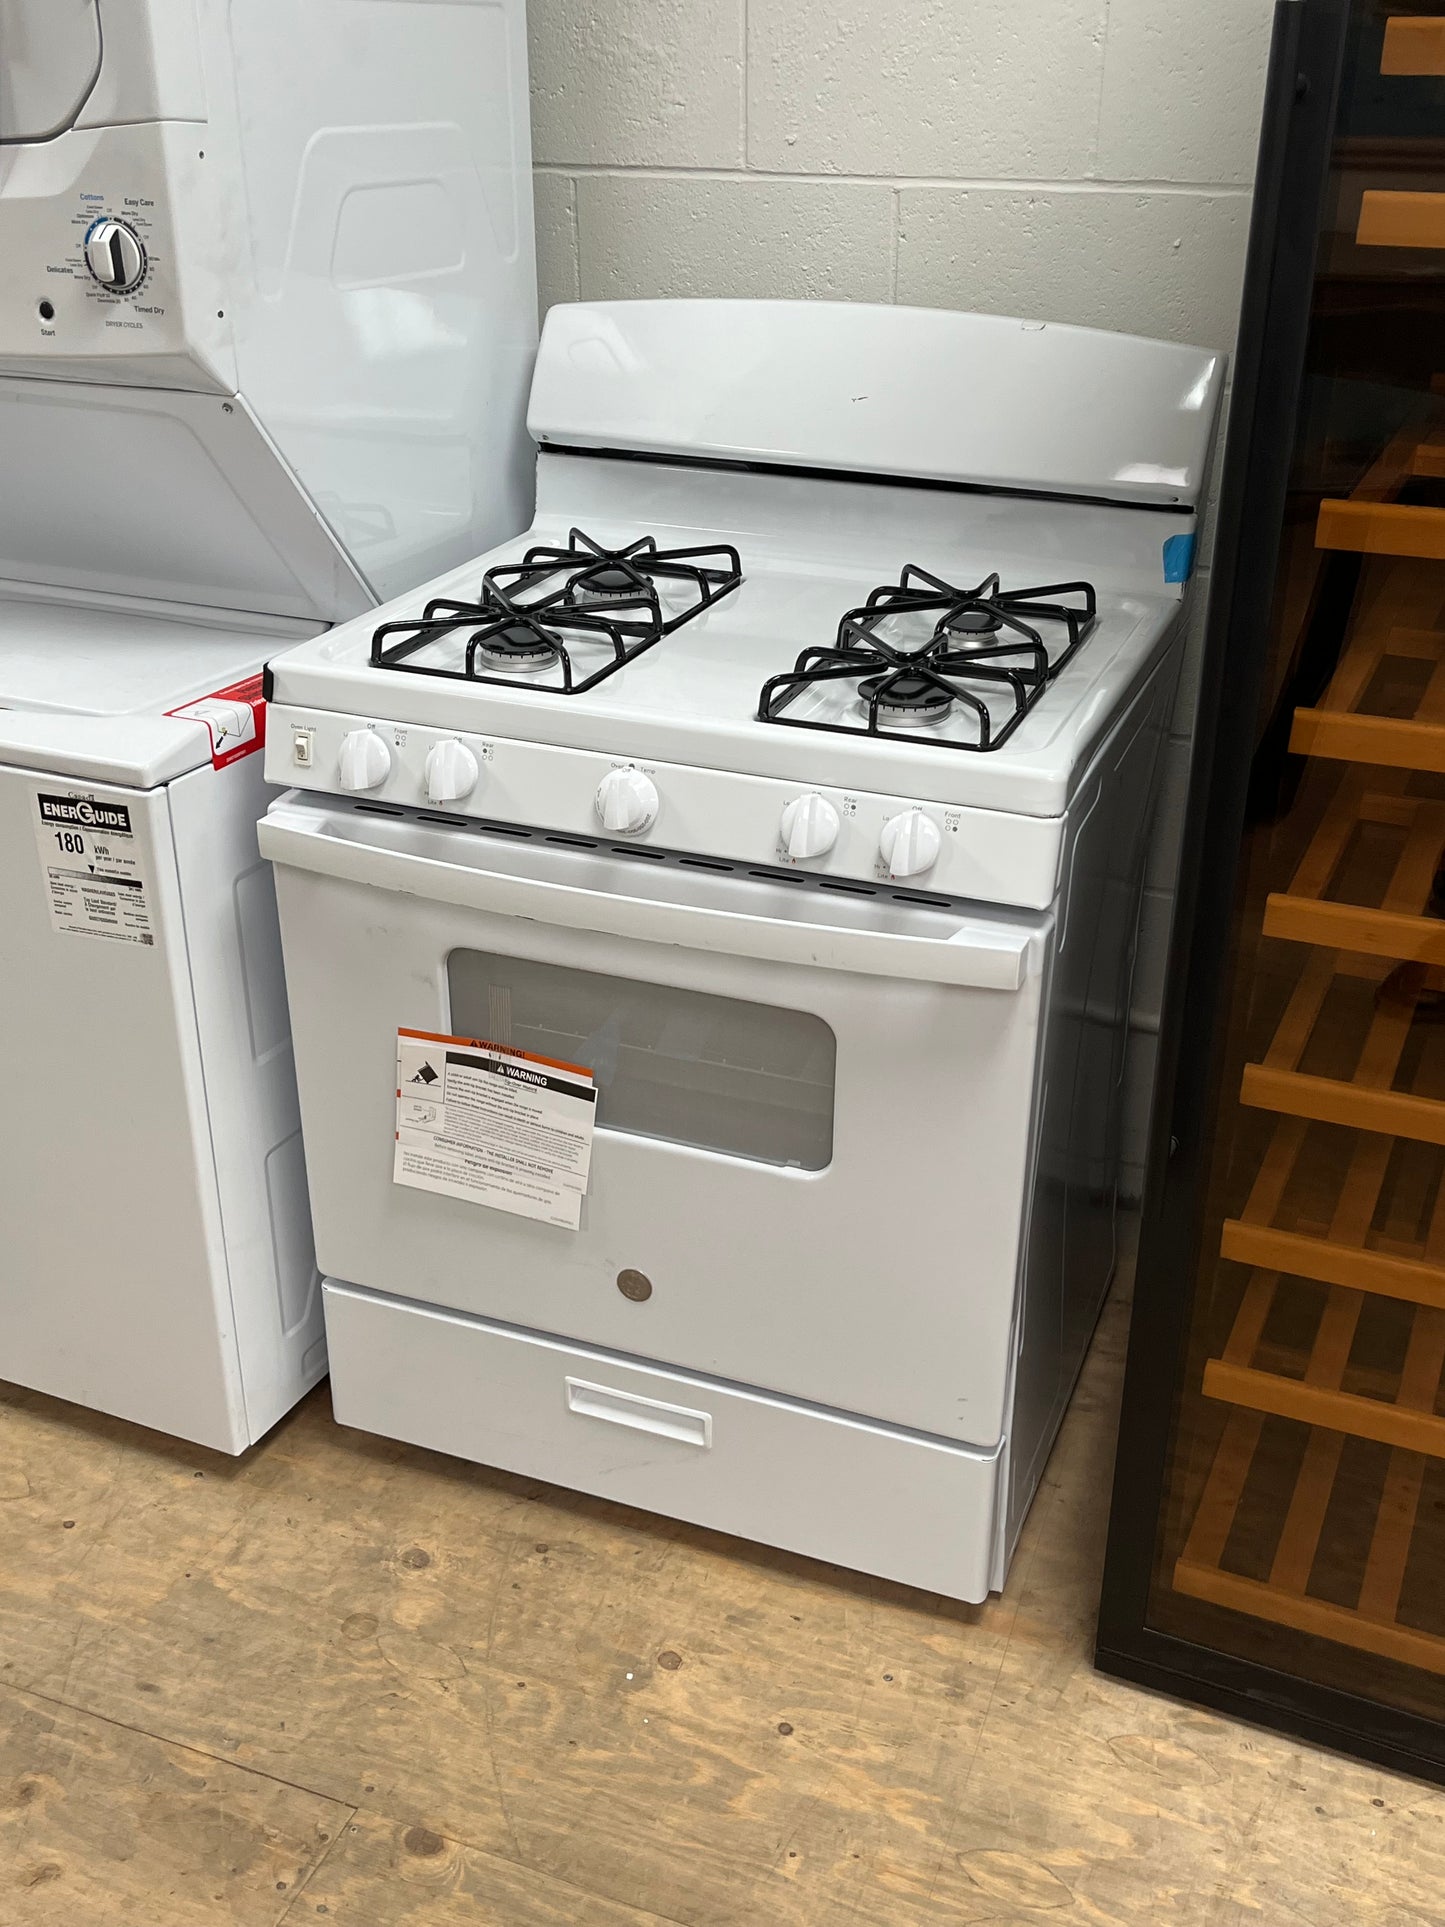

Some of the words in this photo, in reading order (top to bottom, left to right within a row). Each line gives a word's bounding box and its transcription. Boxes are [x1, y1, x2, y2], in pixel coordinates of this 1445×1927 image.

[80, 193, 104, 201] Cottons
[124, 198, 139, 207] Easy
[140, 199, 154, 207] Care
[46, 265, 73, 274] Delicates
[134, 306, 153, 314] Timed
[153, 307, 164, 315] Dry
[105, 320, 122, 328] DRYER
[123, 321, 143, 329] CYCLES
[291, 723, 303, 731] Oven
[42, 801, 127, 826] ENERGUIDE
[945, 811, 961, 819] Front
[54, 831, 84, 855] 180
[94, 845, 110, 855] kWh
[479, 1041, 526, 1059] WARNING!
[506, 1065, 548, 1087] WARNING
